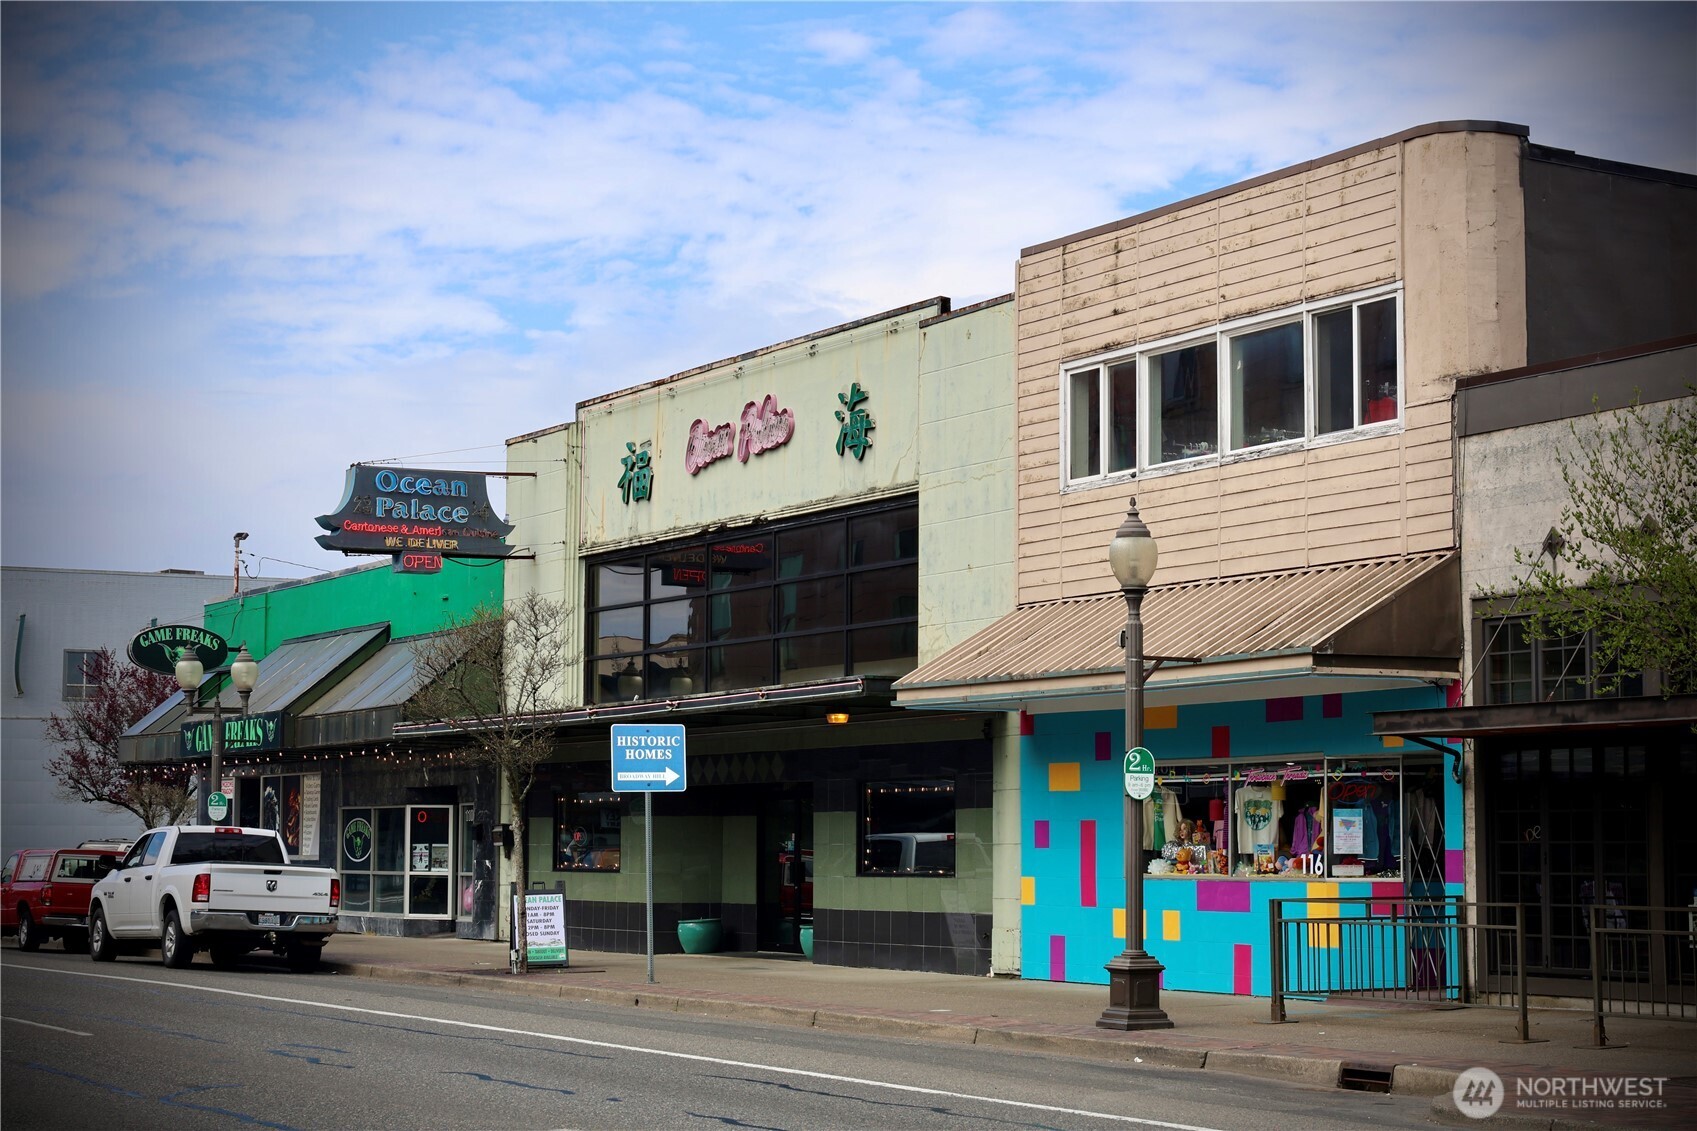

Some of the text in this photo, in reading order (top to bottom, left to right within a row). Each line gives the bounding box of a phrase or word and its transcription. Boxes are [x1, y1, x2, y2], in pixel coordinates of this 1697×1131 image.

[835, 382, 876, 461] 海
[375, 469, 468, 498] Ocean
[375, 497, 469, 523] Palace
[343, 519, 399, 533] Cantonese
[401, 525, 409, 534] &
[384, 537, 459, 550] WE DELIVER
[403, 554, 442, 569] OPEN
[140, 628, 220, 650] GAME FREAKS
[225, 718, 263, 749] FREAKS
[617, 735, 680, 747] HISTORIC
[625, 749, 672, 760] HOMES
[1129, 752, 1141, 771] 2
[1130, 774, 1150, 783] Parking
[1328, 780, 1377, 801] Open
[210, 794, 219, 806] 2
[1300, 853, 1324, 876] 116
[538, 895, 562, 903] PALACE
